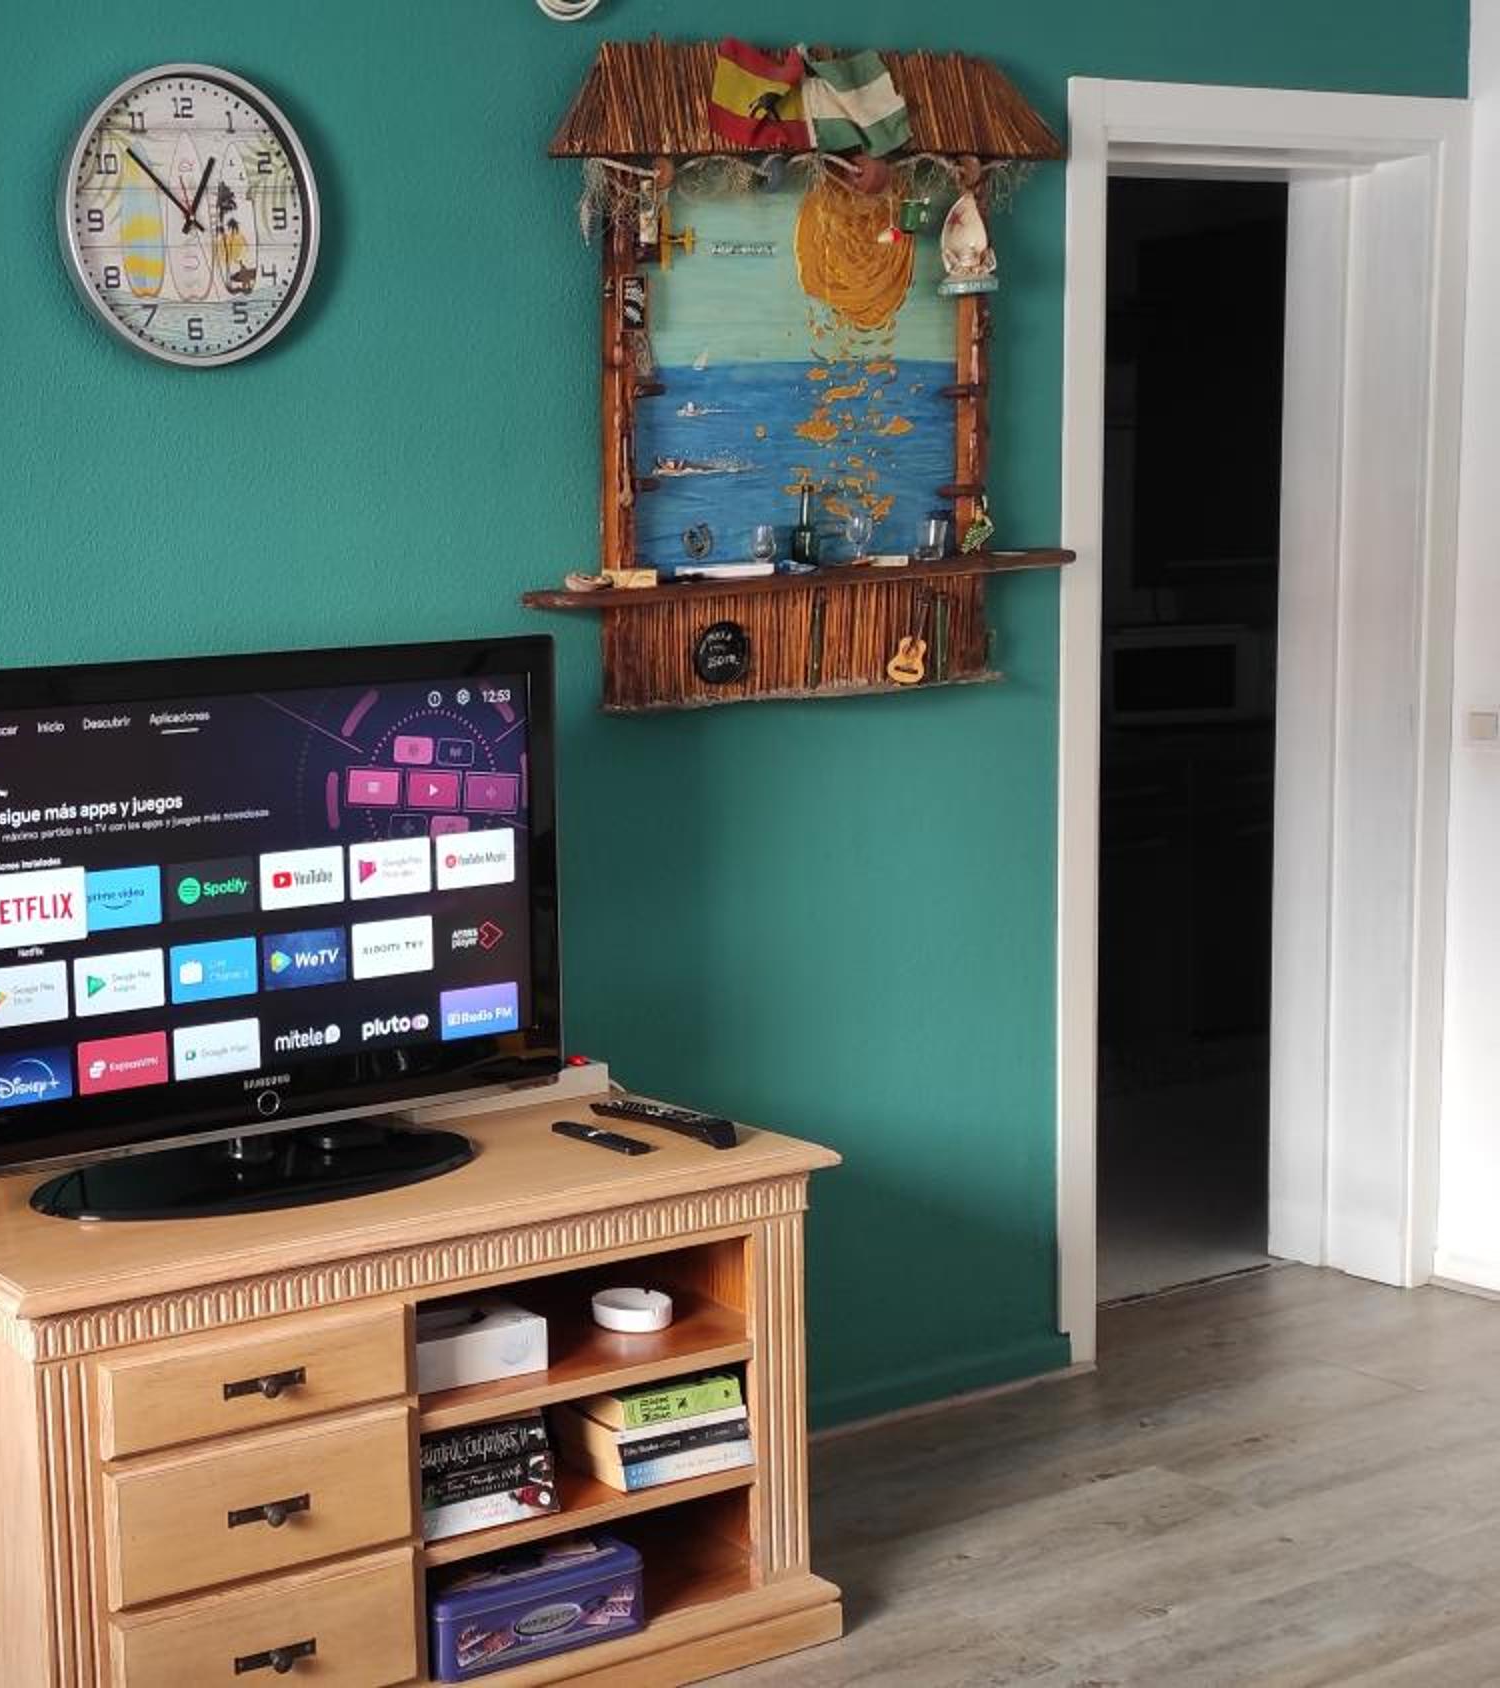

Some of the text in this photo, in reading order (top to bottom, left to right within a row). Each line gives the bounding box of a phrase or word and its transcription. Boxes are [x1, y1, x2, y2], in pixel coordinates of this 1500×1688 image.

[172, 97, 194, 119] 12
[128, 111, 148, 134] 11
[225, 111, 236, 134] 1
[96, 153, 117, 174] 10
[257, 151, 273, 174] 2
[88, 208, 104, 233] 9
[272, 207, 287, 230] 3
[104, 265, 121, 289] 8
[261, 264, 278, 285] 4
[138, 303, 157, 327] 7
[233, 302, 249, 324] 5
[187, 317, 204, 340] 6
[482, 689, 511, 703] 12:53
[37, 722, 65, 734] Inicio
[83, 716, 131, 730] Descubrir
[150, 711, 210, 726] Aplicaciones
[44, 802, 77, 820] más
[80, 802, 117, 820] apps
[120, 801, 129, 818] y
[131, 796, 183, 816] juegos
[41, 827, 74, 840] partido
[95, 824, 107, 833] TV
[172, 816, 201, 828] juegos
[203, 877, 248, 898] Spotify
[293, 868, 332, 888] YouTube
[17, 947, 44, 958] Netflix
[295, 948, 340, 969] WeTV
[462, 1006, 513, 1024] Radio FM
[362, 1015, 411, 1041] pluto
[275, 1028, 323, 1052] mitele
